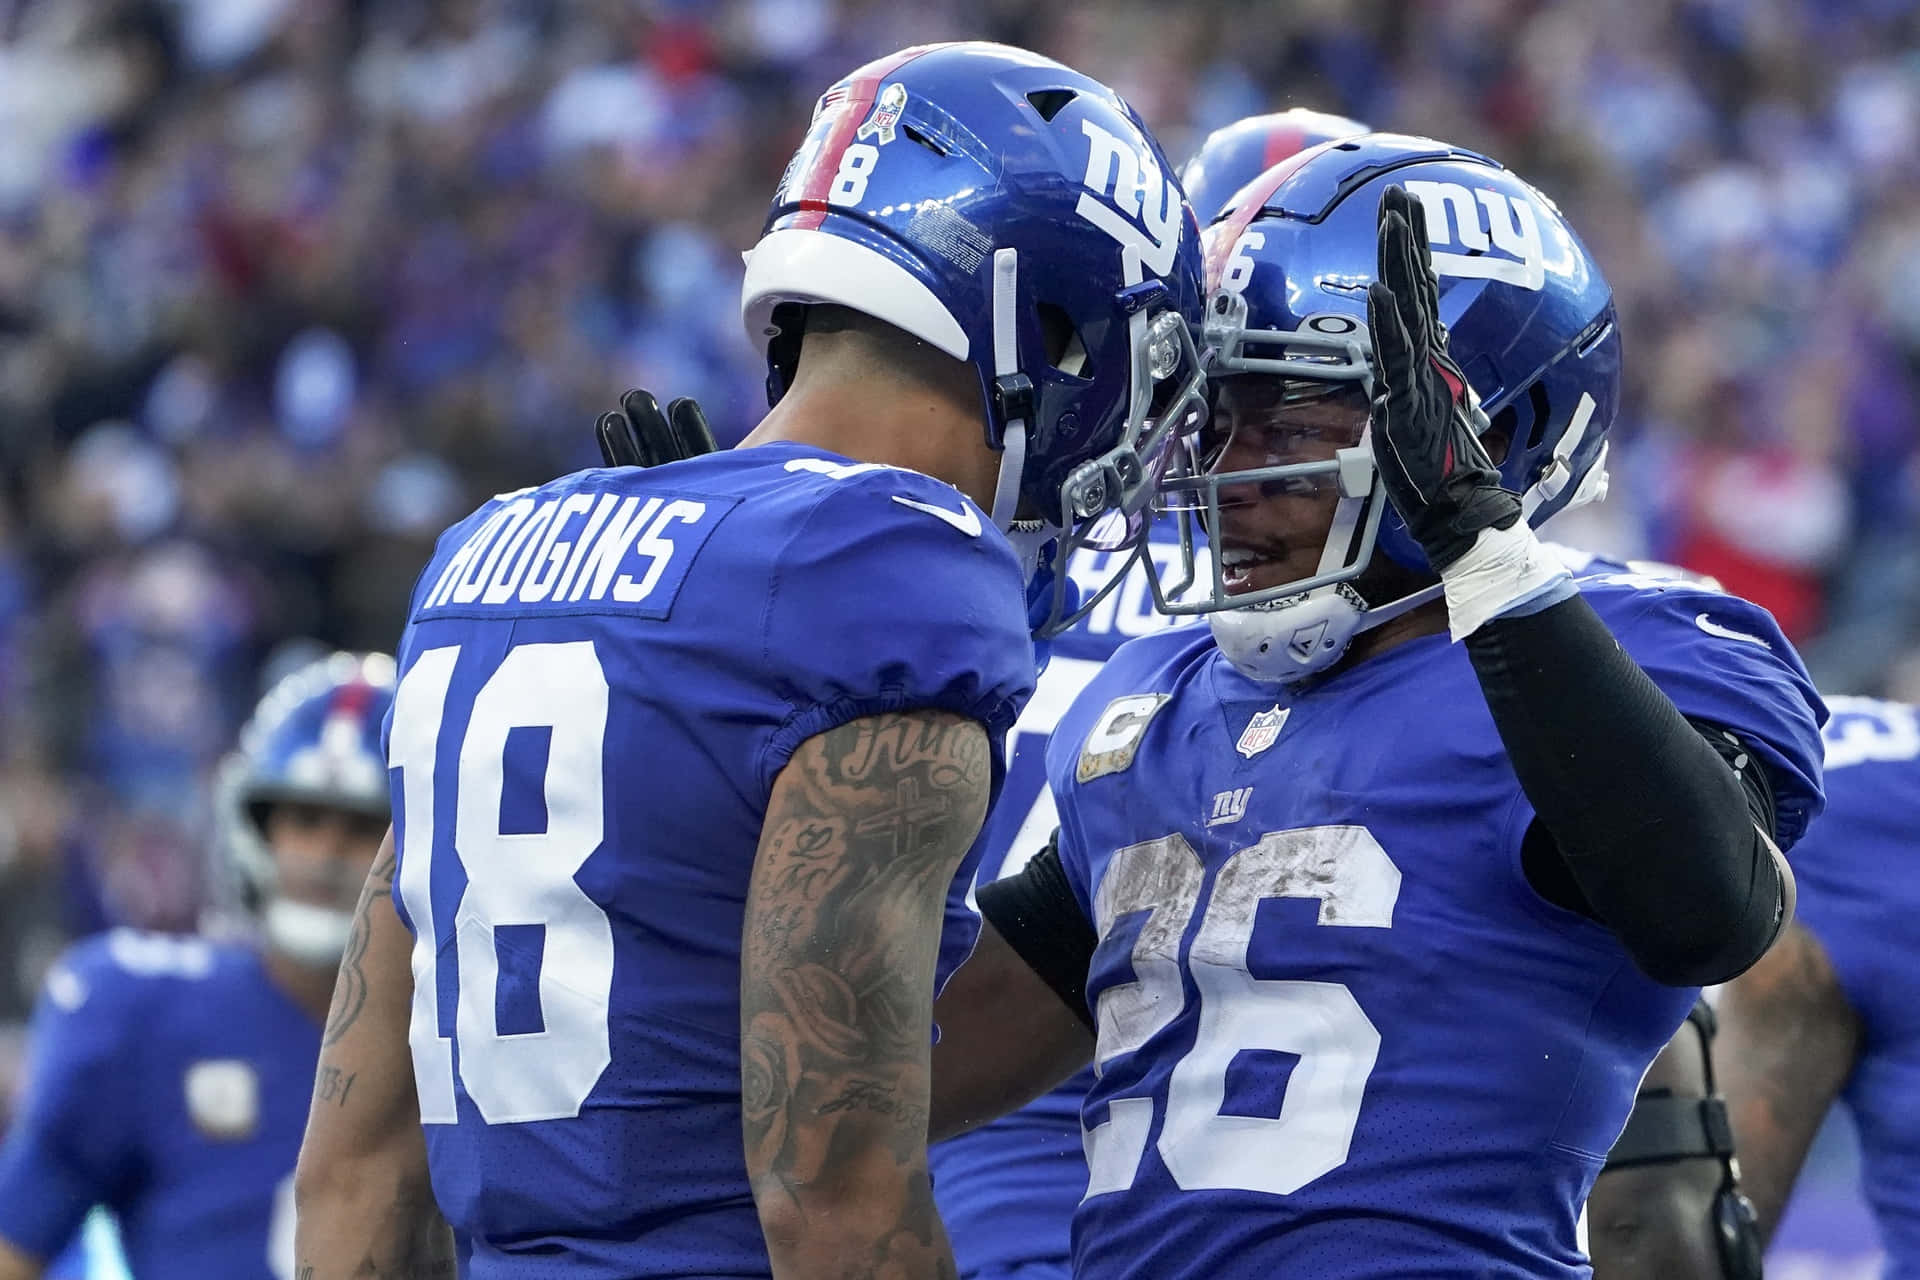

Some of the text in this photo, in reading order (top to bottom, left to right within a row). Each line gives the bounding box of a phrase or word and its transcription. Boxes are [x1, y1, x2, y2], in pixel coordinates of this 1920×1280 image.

[828, 143, 880, 208] 8
[1221, 231, 1266, 294] 6
[424, 492, 706, 608] HODGINS
[388, 640, 611, 1125] 18
[1079, 825, 1403, 1207] 26
